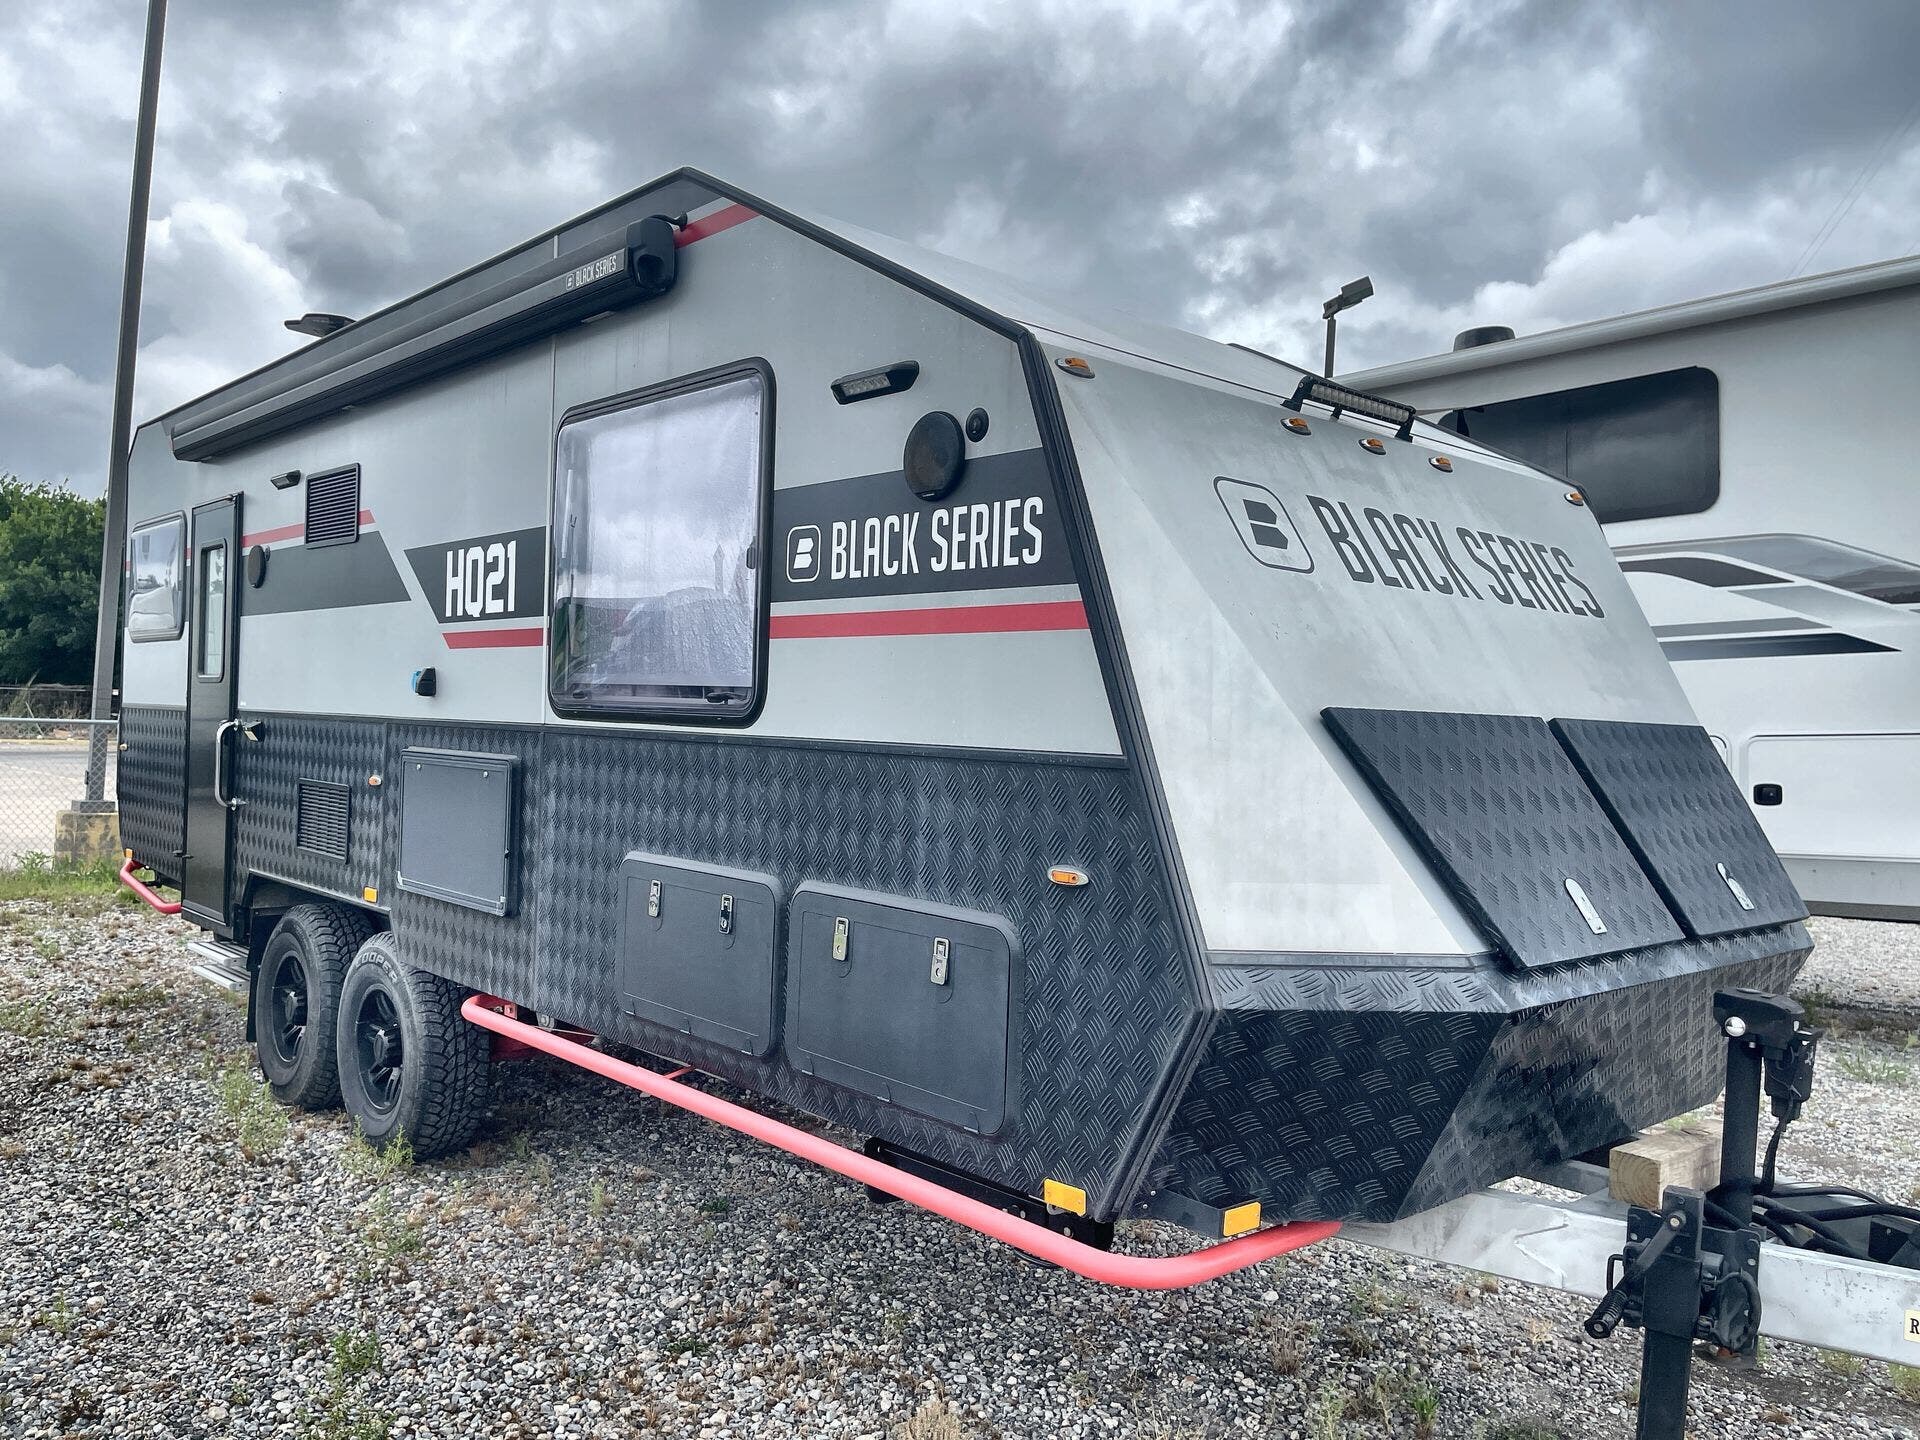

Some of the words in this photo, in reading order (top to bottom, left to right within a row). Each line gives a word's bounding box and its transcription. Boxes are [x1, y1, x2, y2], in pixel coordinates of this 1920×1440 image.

[575, 264, 595, 287] BLACK
[595, 255, 617, 279] SERIES
[831, 511, 920, 580] BLACK
[930, 496, 1044, 572] SERIES
[1306, 494, 1484, 601] BLACK
[1456, 527, 1605, 619] SERIES
[445, 540, 517, 618] HQ21
[355, 951, 398, 983] COOPER
